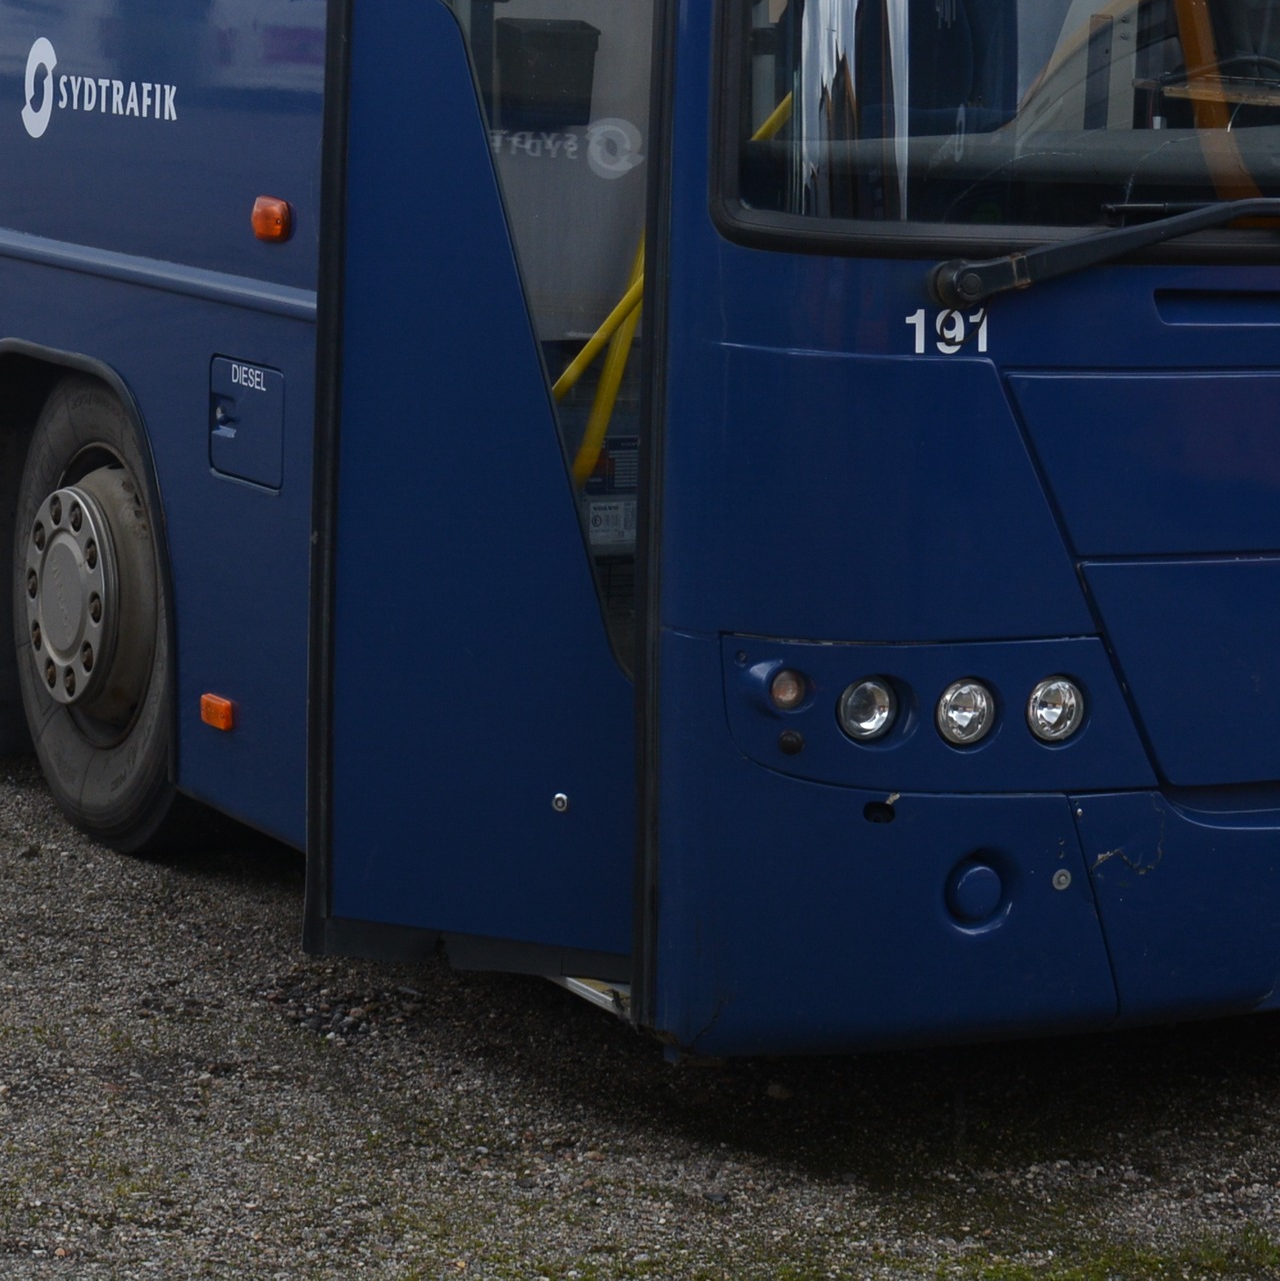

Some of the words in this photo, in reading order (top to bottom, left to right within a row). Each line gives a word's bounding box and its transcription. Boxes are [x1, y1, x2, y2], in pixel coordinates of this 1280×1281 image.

[58, 73, 178, 122] SYDTRAFIK
[905, 308, 988, 354] 191
[231, 363, 267, 392] DIESEL
